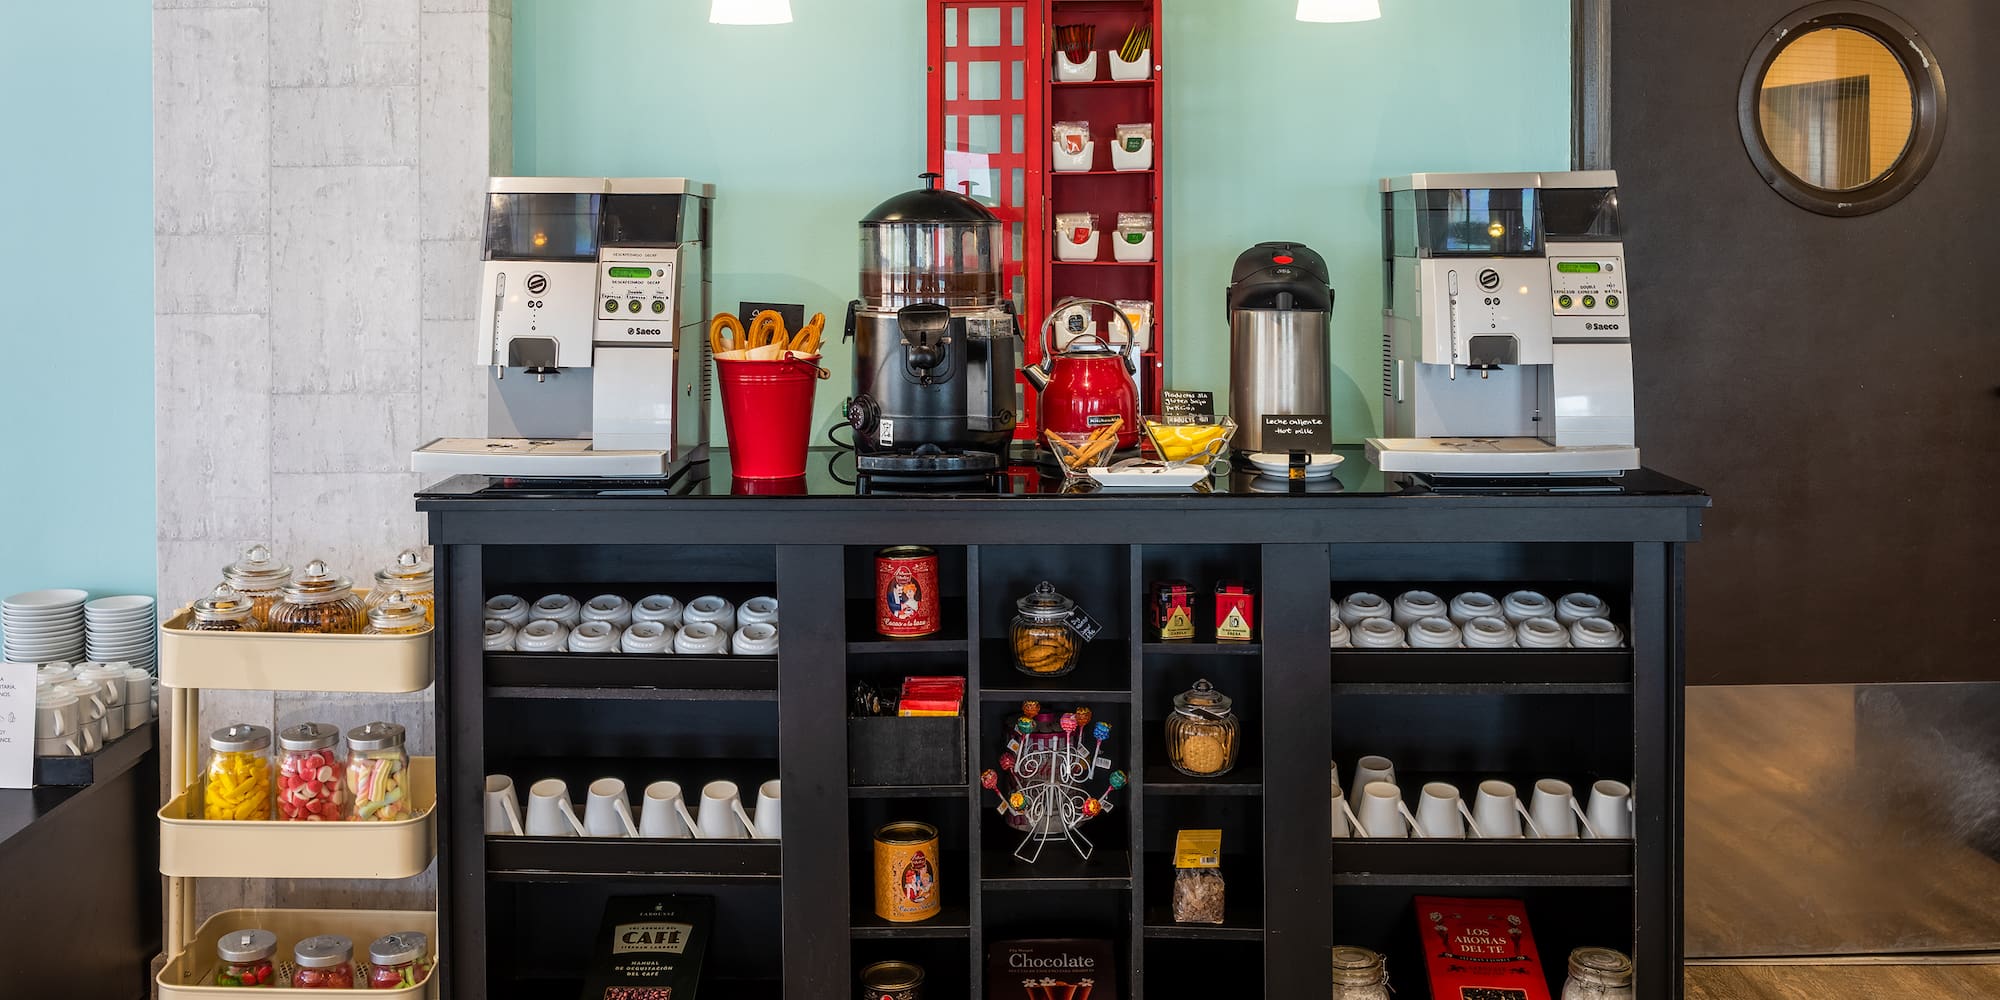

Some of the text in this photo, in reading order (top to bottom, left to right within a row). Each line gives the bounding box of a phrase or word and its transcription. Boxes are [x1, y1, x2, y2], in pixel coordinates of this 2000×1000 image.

[1466, 928, 1490, 936] LOS
[622, 930, 681, 944] CAFÉ
[1454, 936, 1507, 944] AROMAS
[1461, 944, 1486, 953] DEL
[1008, 953, 1095, 968] Chocolate
